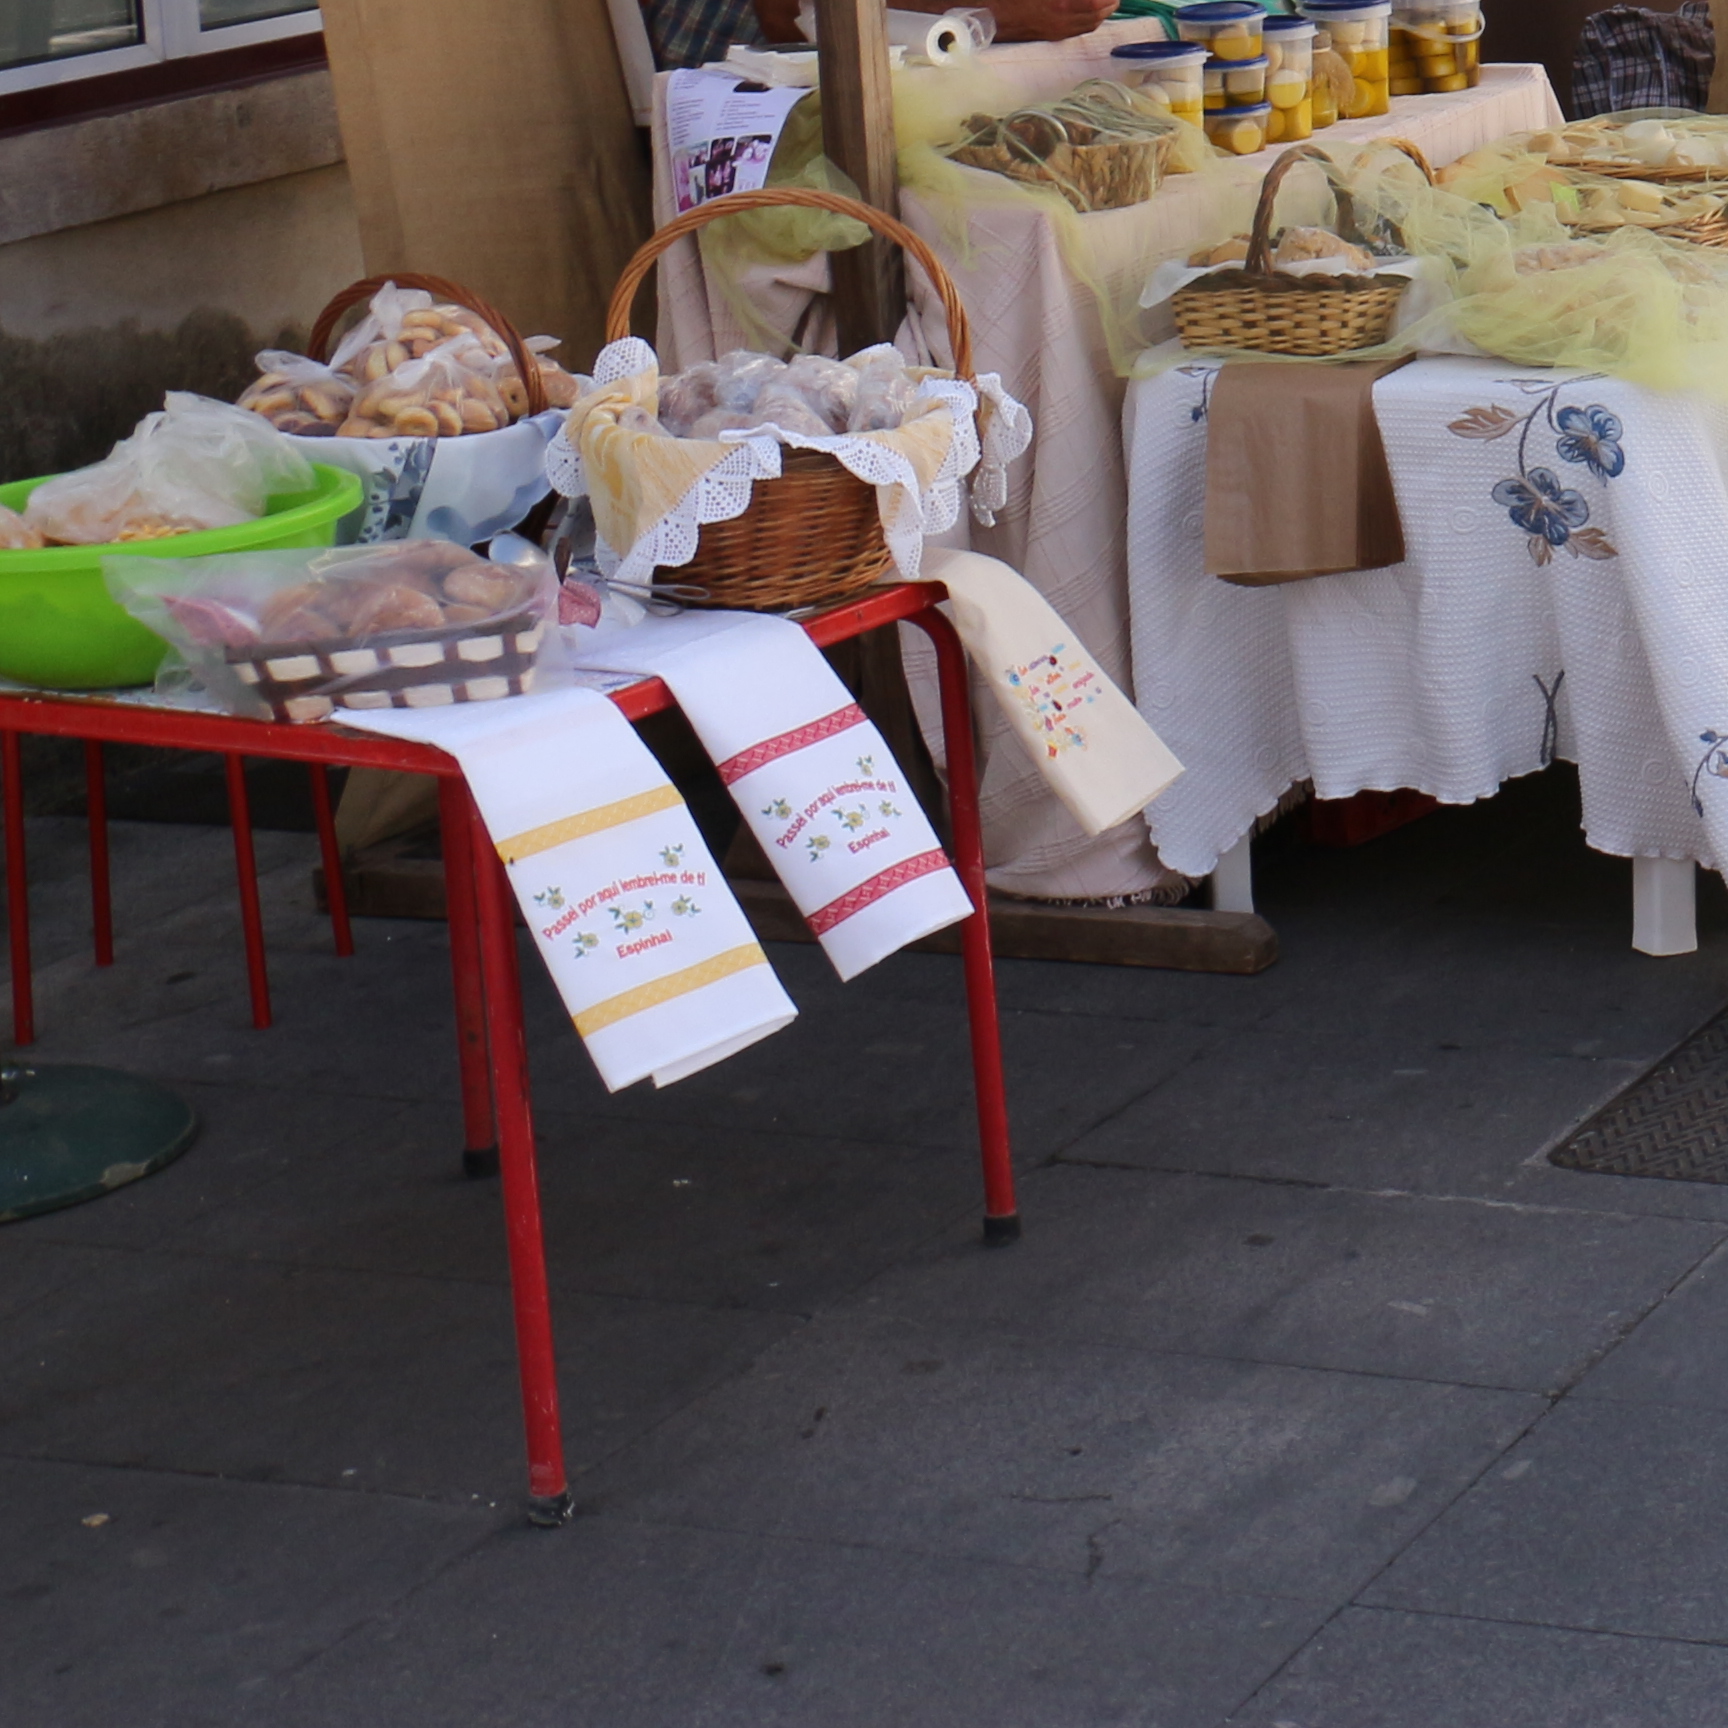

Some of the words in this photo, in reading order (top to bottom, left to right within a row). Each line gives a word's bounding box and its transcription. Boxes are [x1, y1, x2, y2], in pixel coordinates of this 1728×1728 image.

[776, 812, 807, 849] Passei
[804, 800, 819, 820] por
[818, 787, 836, 807] aqui
[876, 779, 887, 791] de
[848, 827, 890, 853] Espinhal
[542, 907, 579, 941] Passei
[578, 894, 597, 917] por
[597, 881, 620, 903] aqui
[618, 871, 677, 893] lembrei-me
[680, 870, 695, 884] de
[697, 872, 706, 886] ti
[616, 928, 674, 959] Espinhal
